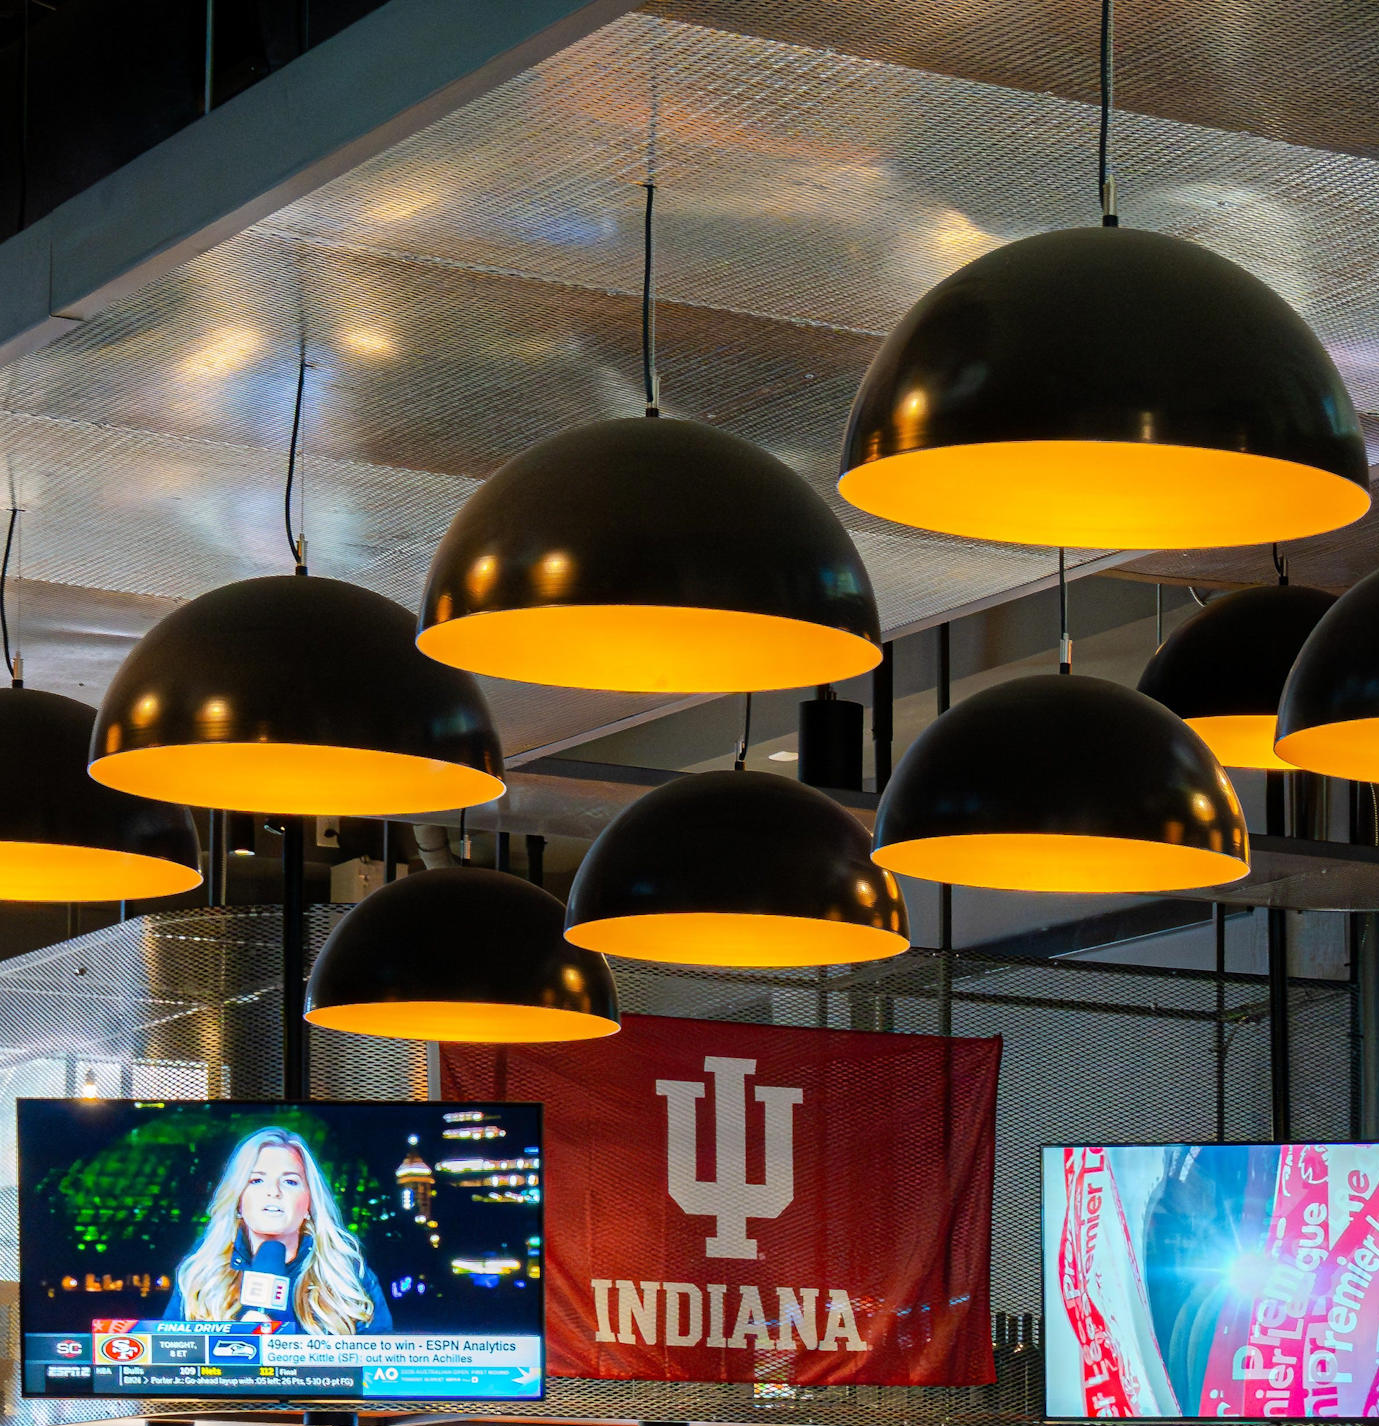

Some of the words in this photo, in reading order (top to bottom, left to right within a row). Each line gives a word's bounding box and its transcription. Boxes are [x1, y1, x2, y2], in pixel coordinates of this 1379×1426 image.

[591, 1278, 868, 1352] INDIANA
[157, 1324, 193, 1333] FINAL
[195, 1324, 232, 1333] DRIVE
[268, 1340, 303, 1350] 49ers:
[307, 1340, 332, 1350] 40%
[335, 1340, 378, 1351] chance
[380, 1340, 392, 1350] to
[396, 1341, 415, 1350] win
[426, 1340, 459, 1351] ESPN
[463, 1339, 516, 1353] Analytics
[268, 1353, 306, 1364] George
[309, 1352, 334, 1362] Kittle
[366, 1354, 382, 1363] out
[384, 1353, 406, 1362] with
[409, 1354, 429, 1363] torn
[432, 1353, 472, 1363] Achilles
